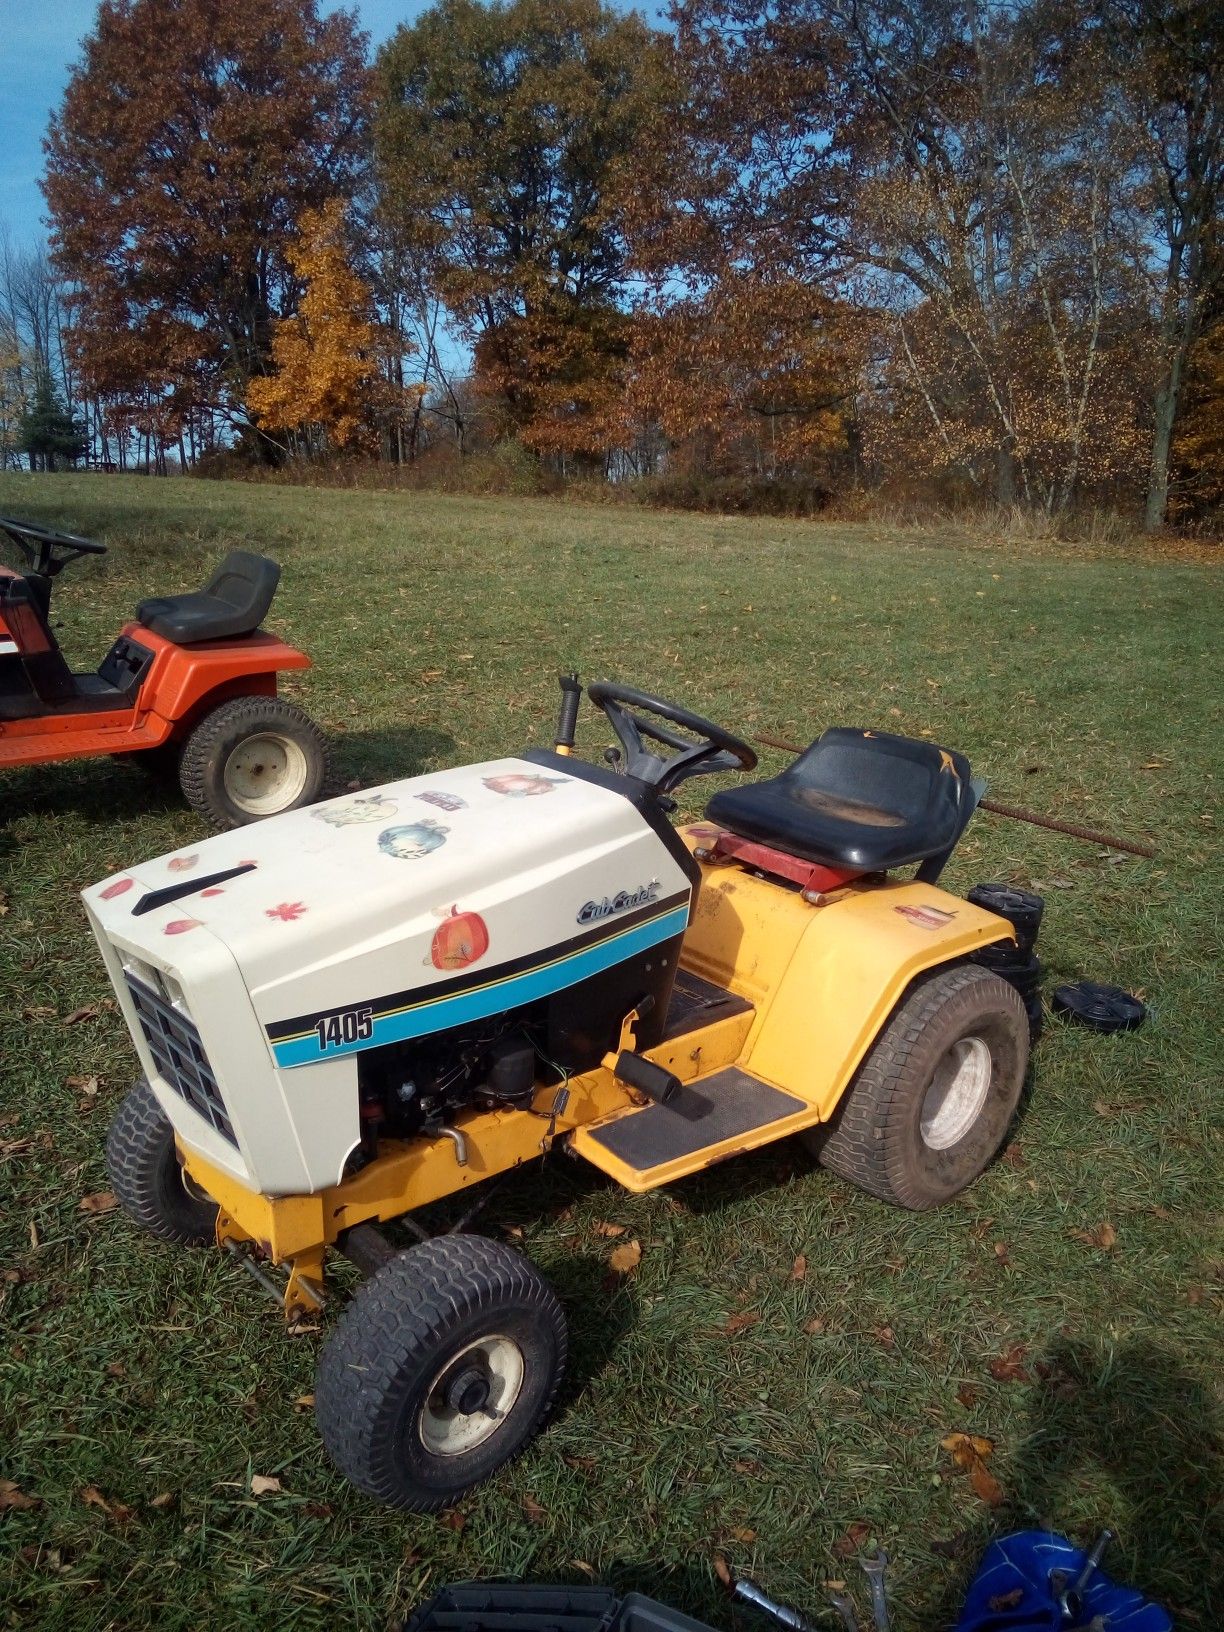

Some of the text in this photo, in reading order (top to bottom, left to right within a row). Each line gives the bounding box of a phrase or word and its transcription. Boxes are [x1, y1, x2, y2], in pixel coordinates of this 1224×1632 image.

[577, 881, 661, 924] Cub Cadet
[315, 1007, 373, 1051] 1405
